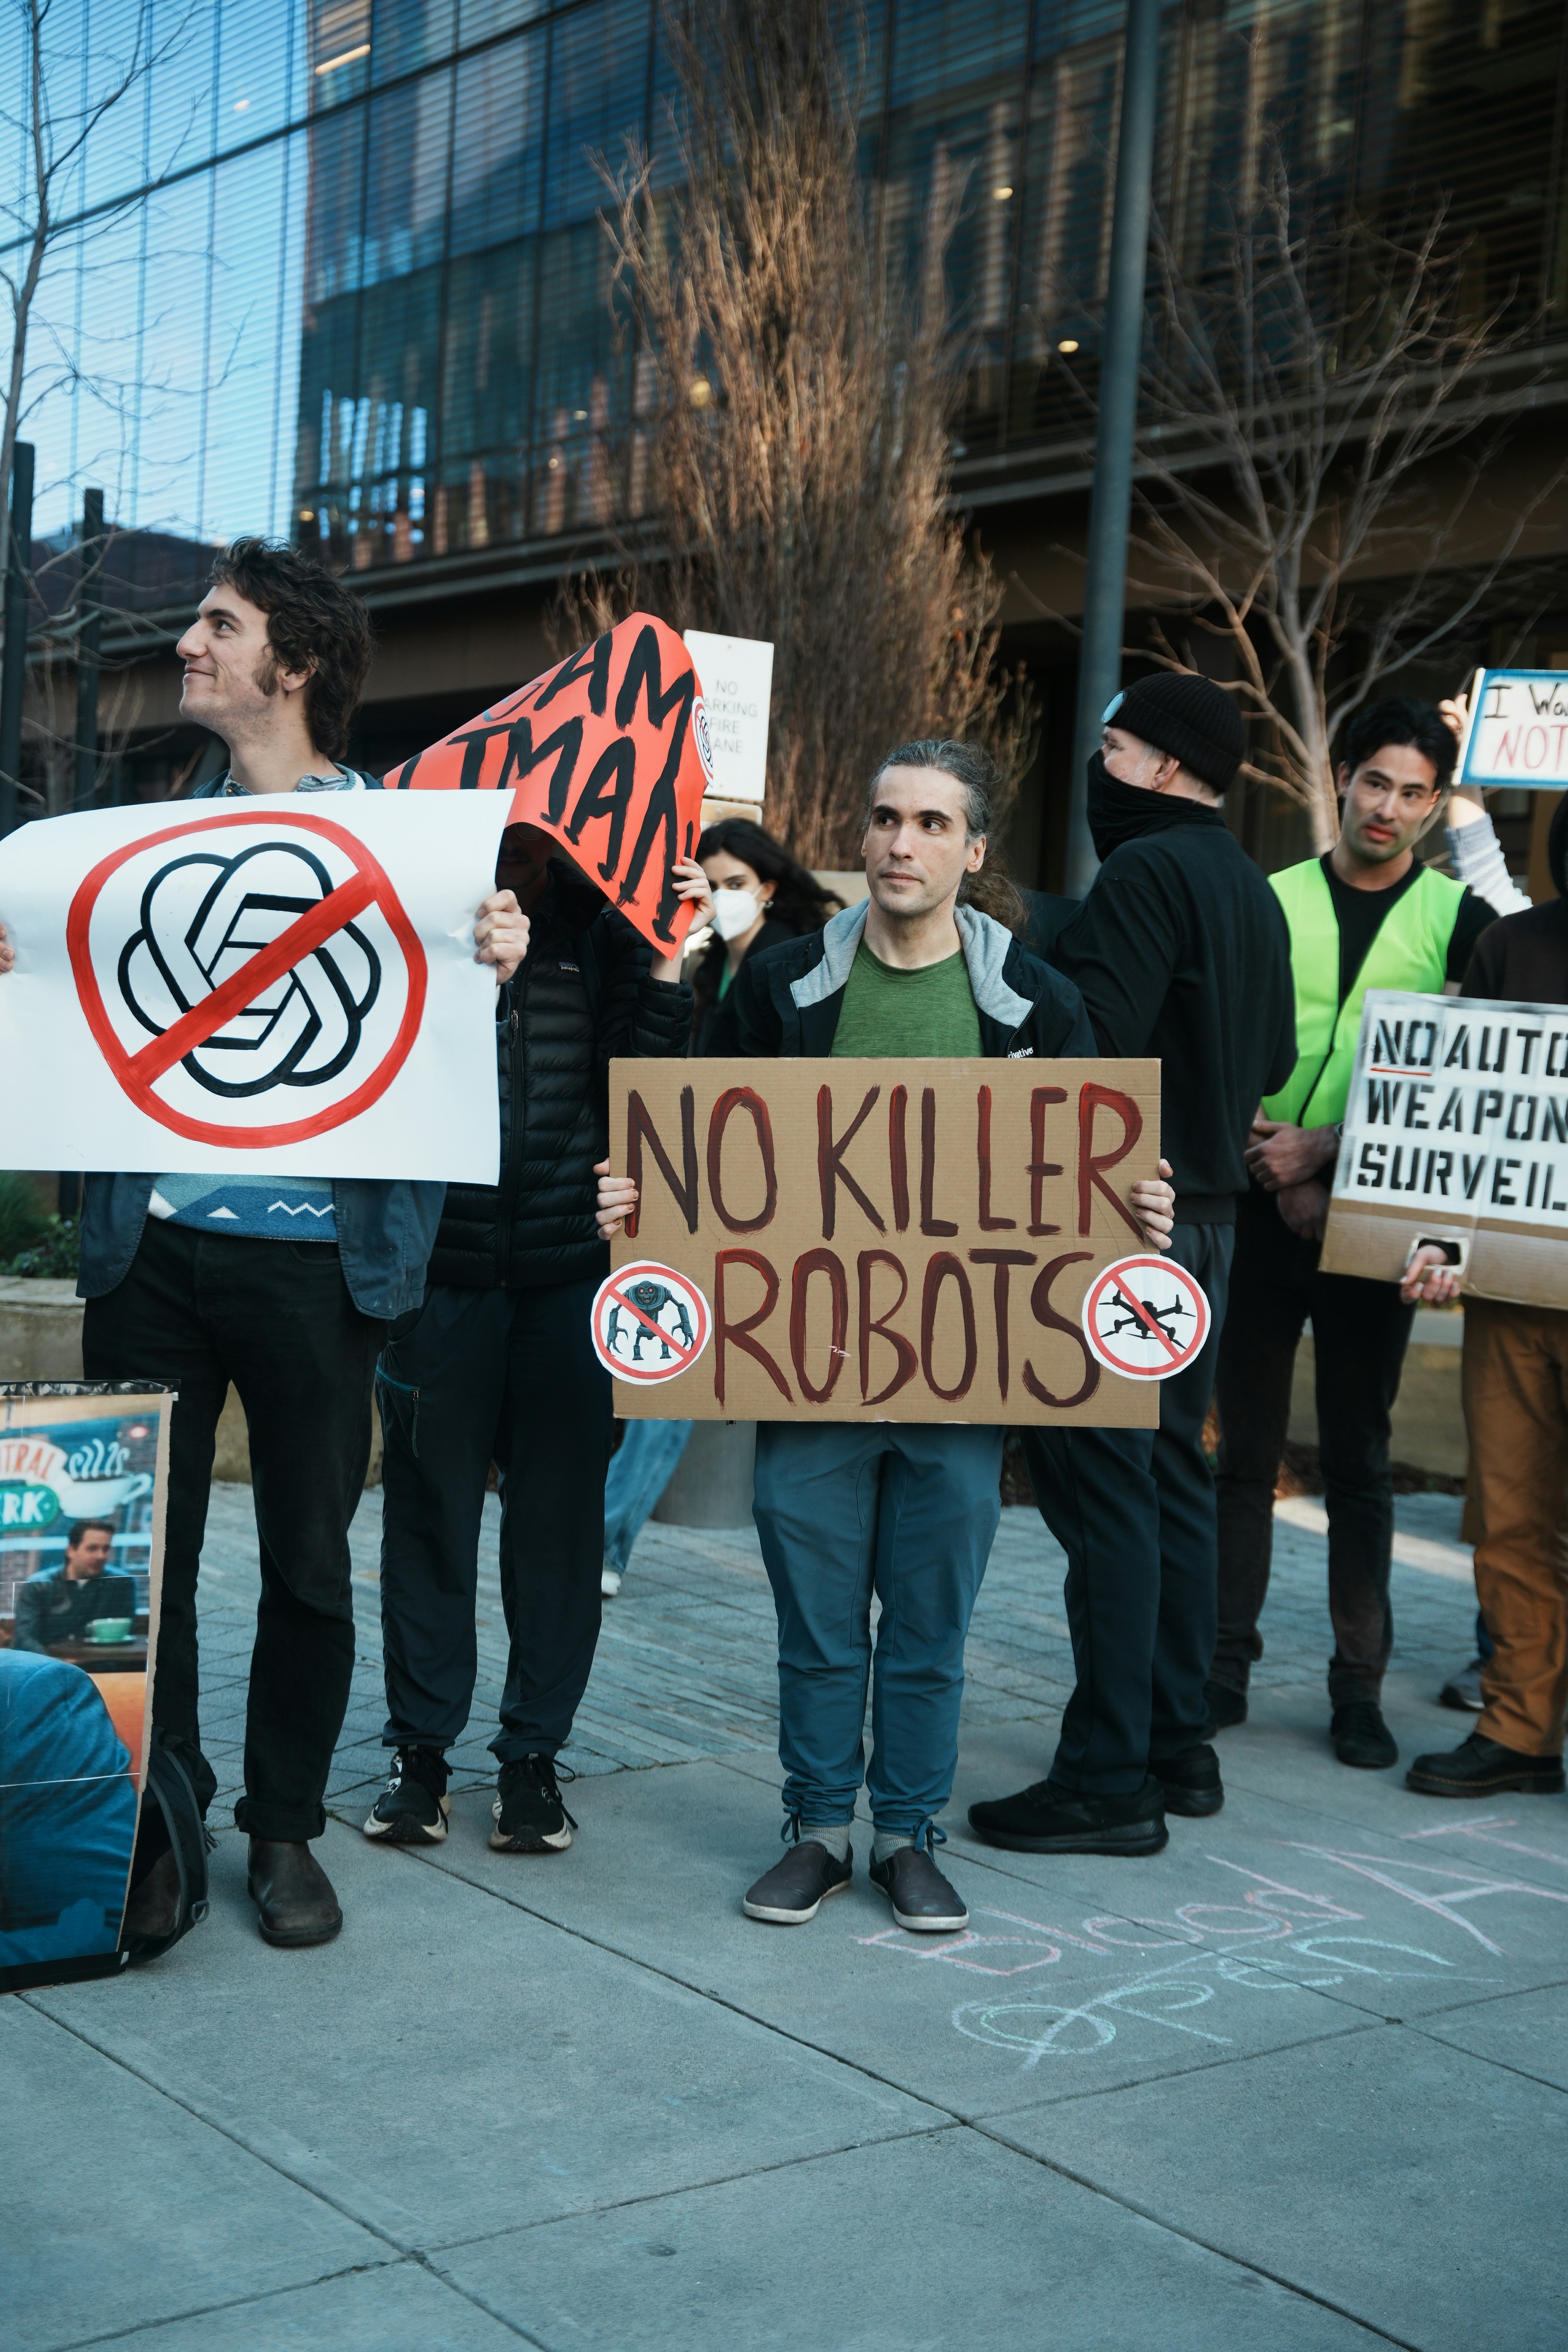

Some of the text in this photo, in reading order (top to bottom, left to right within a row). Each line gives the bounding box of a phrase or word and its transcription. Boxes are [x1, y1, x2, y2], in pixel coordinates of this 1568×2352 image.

[483, 625, 695, 776] AM
[704, 697, 758, 717] ARKING
[716, 679, 739, 695] NO
[1485, 682, 1568, 719] I Wa
[709, 717, 740, 734] FIRE
[713, 737, 744, 753] ANE
[1492, 723, 1568, 772] NOT
[380, 716, 694, 944] TMAN
[1371, 1019, 1439, 1067] NO
[1367, 1079, 1568, 1143] WEAPON
[624, 1081, 1146, 1249] NO KILLER
[1357, 1142, 1567, 1212] SURVEIL
[714, 1247, 1104, 1413] ROBOTS
[0, 1443, 55, 1480] TRAL
[0, 1490, 46, 1525] RK
